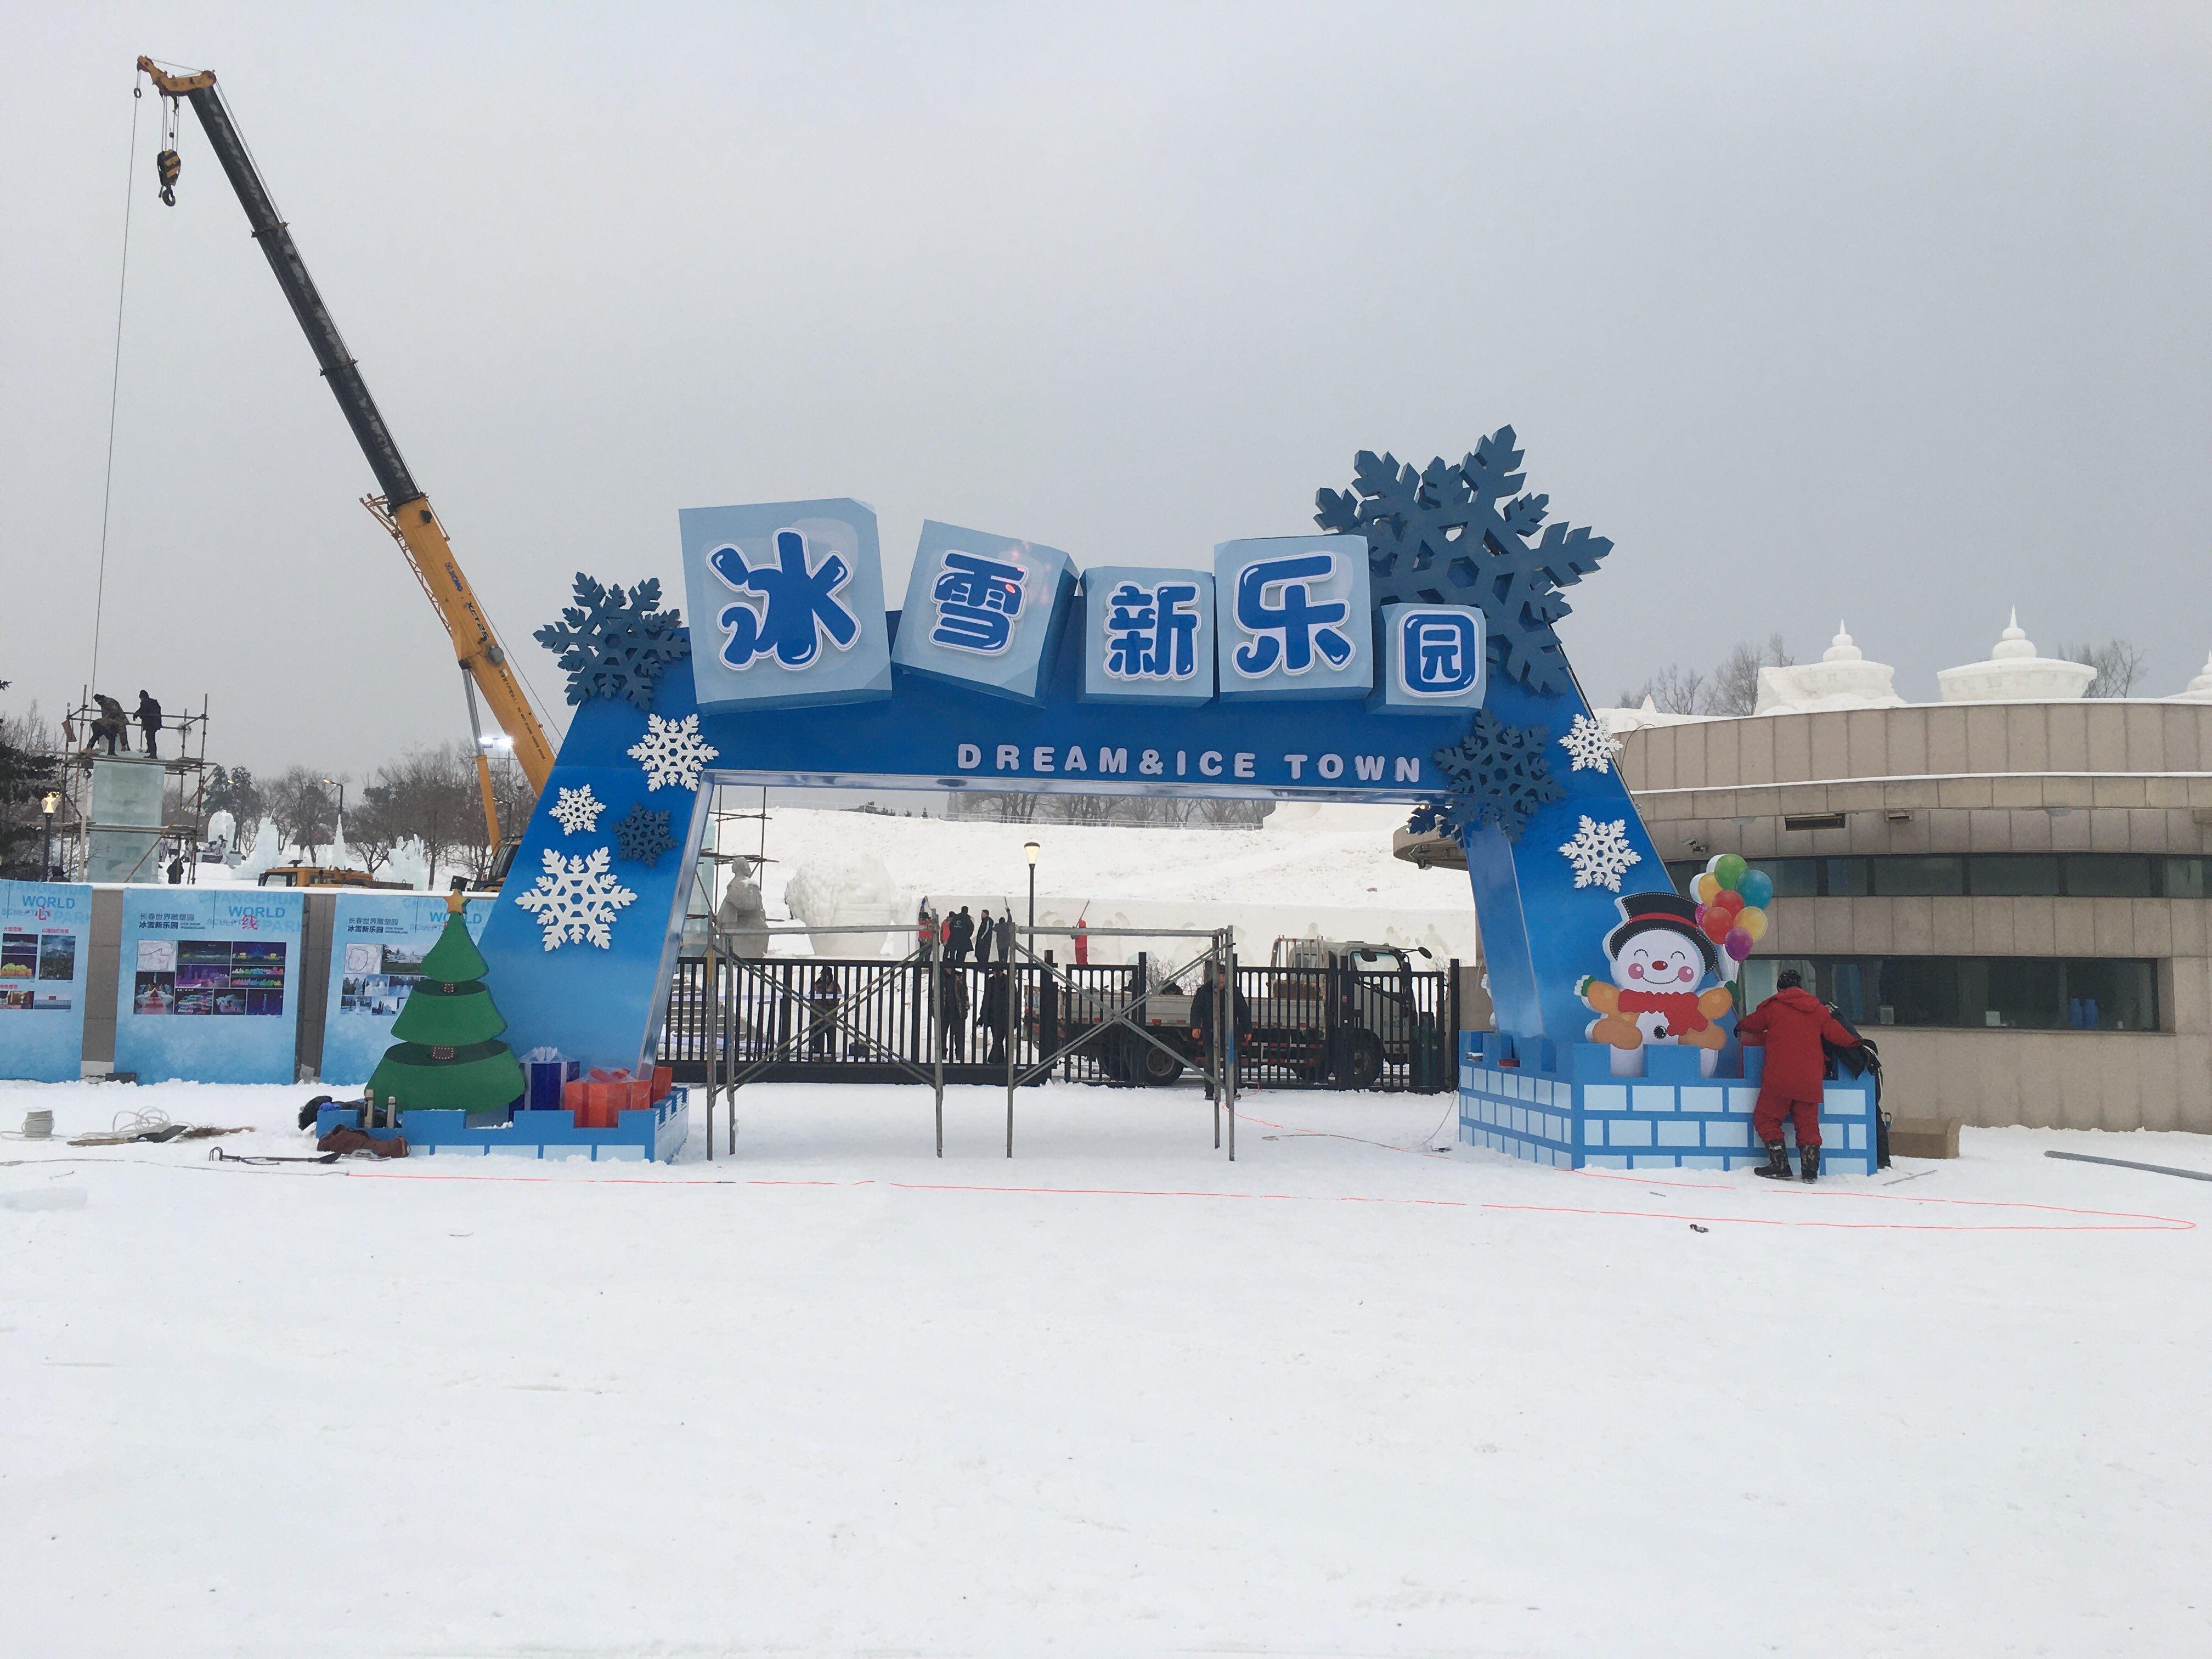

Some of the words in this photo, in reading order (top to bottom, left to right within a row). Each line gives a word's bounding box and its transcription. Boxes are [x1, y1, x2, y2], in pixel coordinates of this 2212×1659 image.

[706, 528, 1480, 698] 冰雪新乐园
[957, 743, 1256, 778] DREAM&ICE
[1283, 754, 1420, 783] TOWN
[22, 895, 76, 909] WORLD
[228, 906, 286, 918] WORLD
[430, 911, 482, 924] WOLD
[139, 921, 179, 929] 冰雪新乐园
